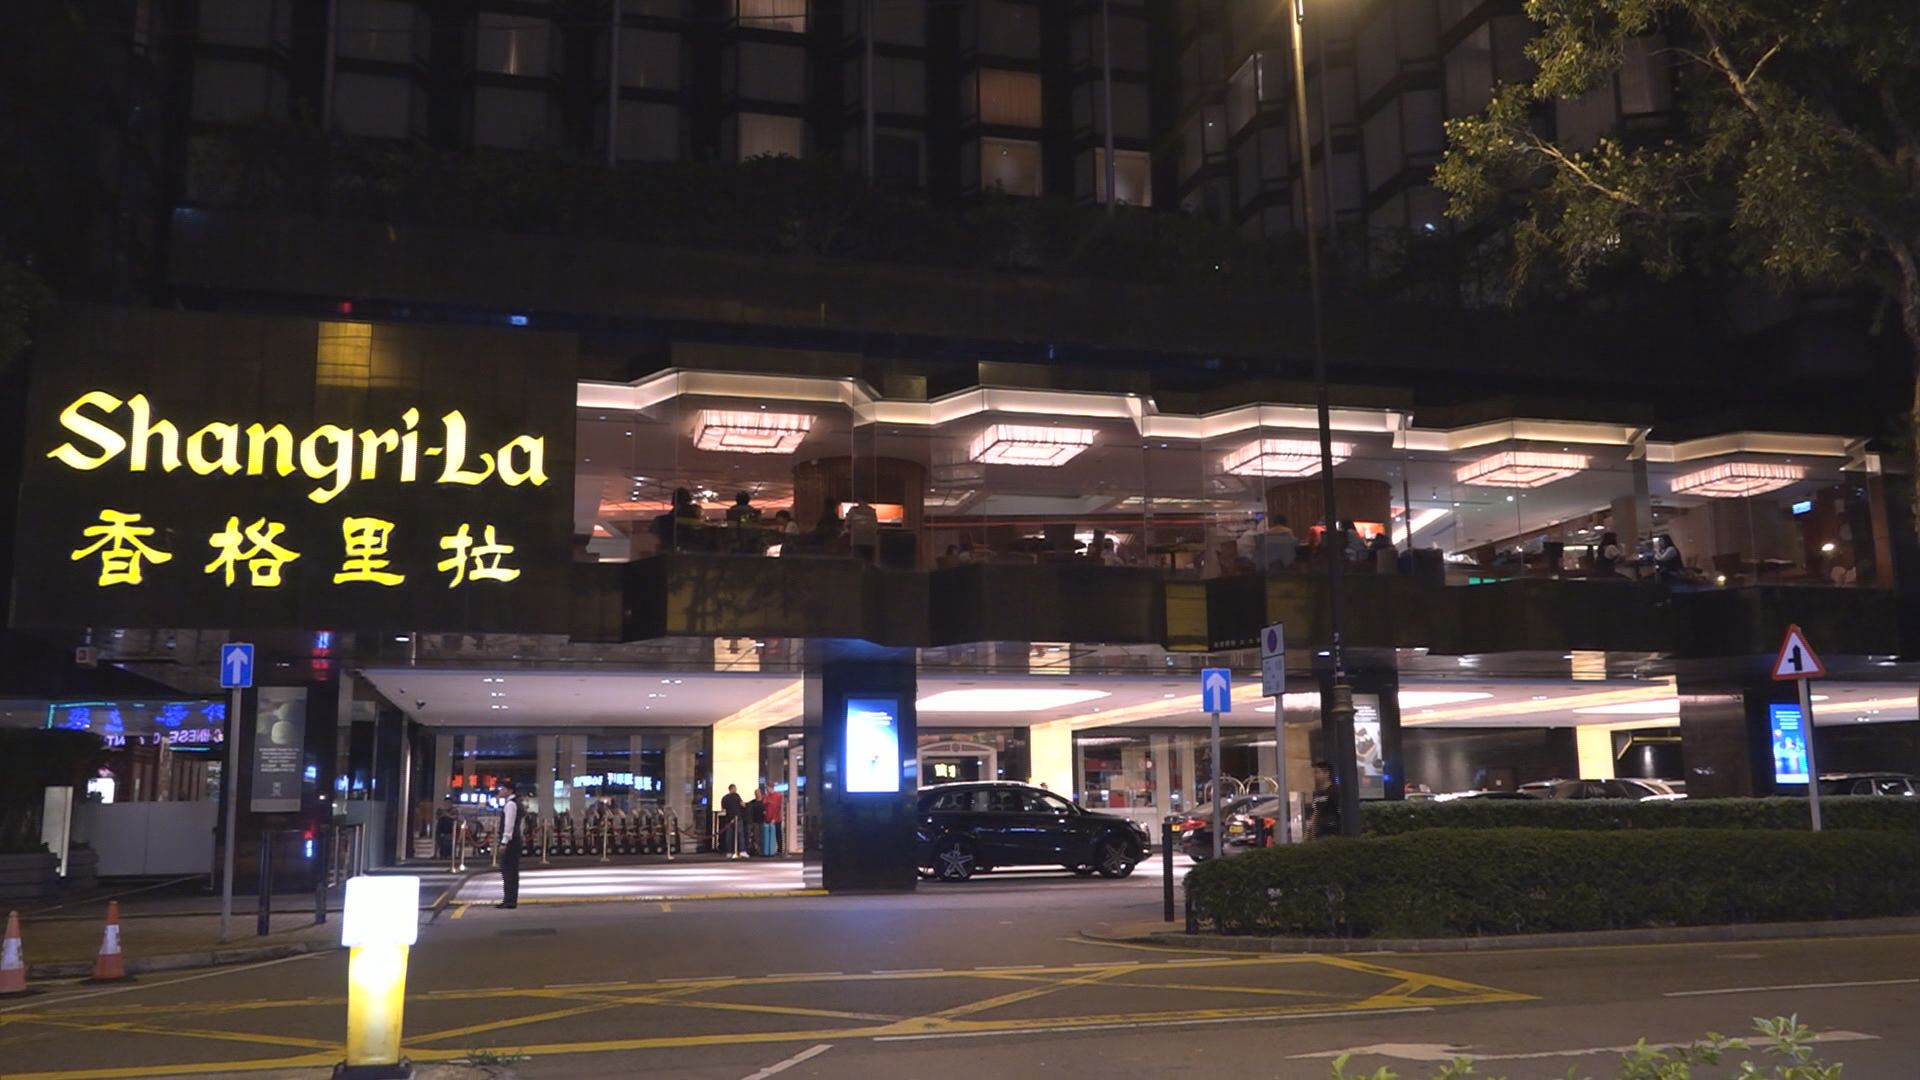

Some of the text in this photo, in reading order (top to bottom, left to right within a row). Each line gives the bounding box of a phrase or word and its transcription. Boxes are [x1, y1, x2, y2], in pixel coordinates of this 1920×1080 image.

[46, 390, 549, 504] Shangri-La
[70, 508, 522, 588] 香格里拉
